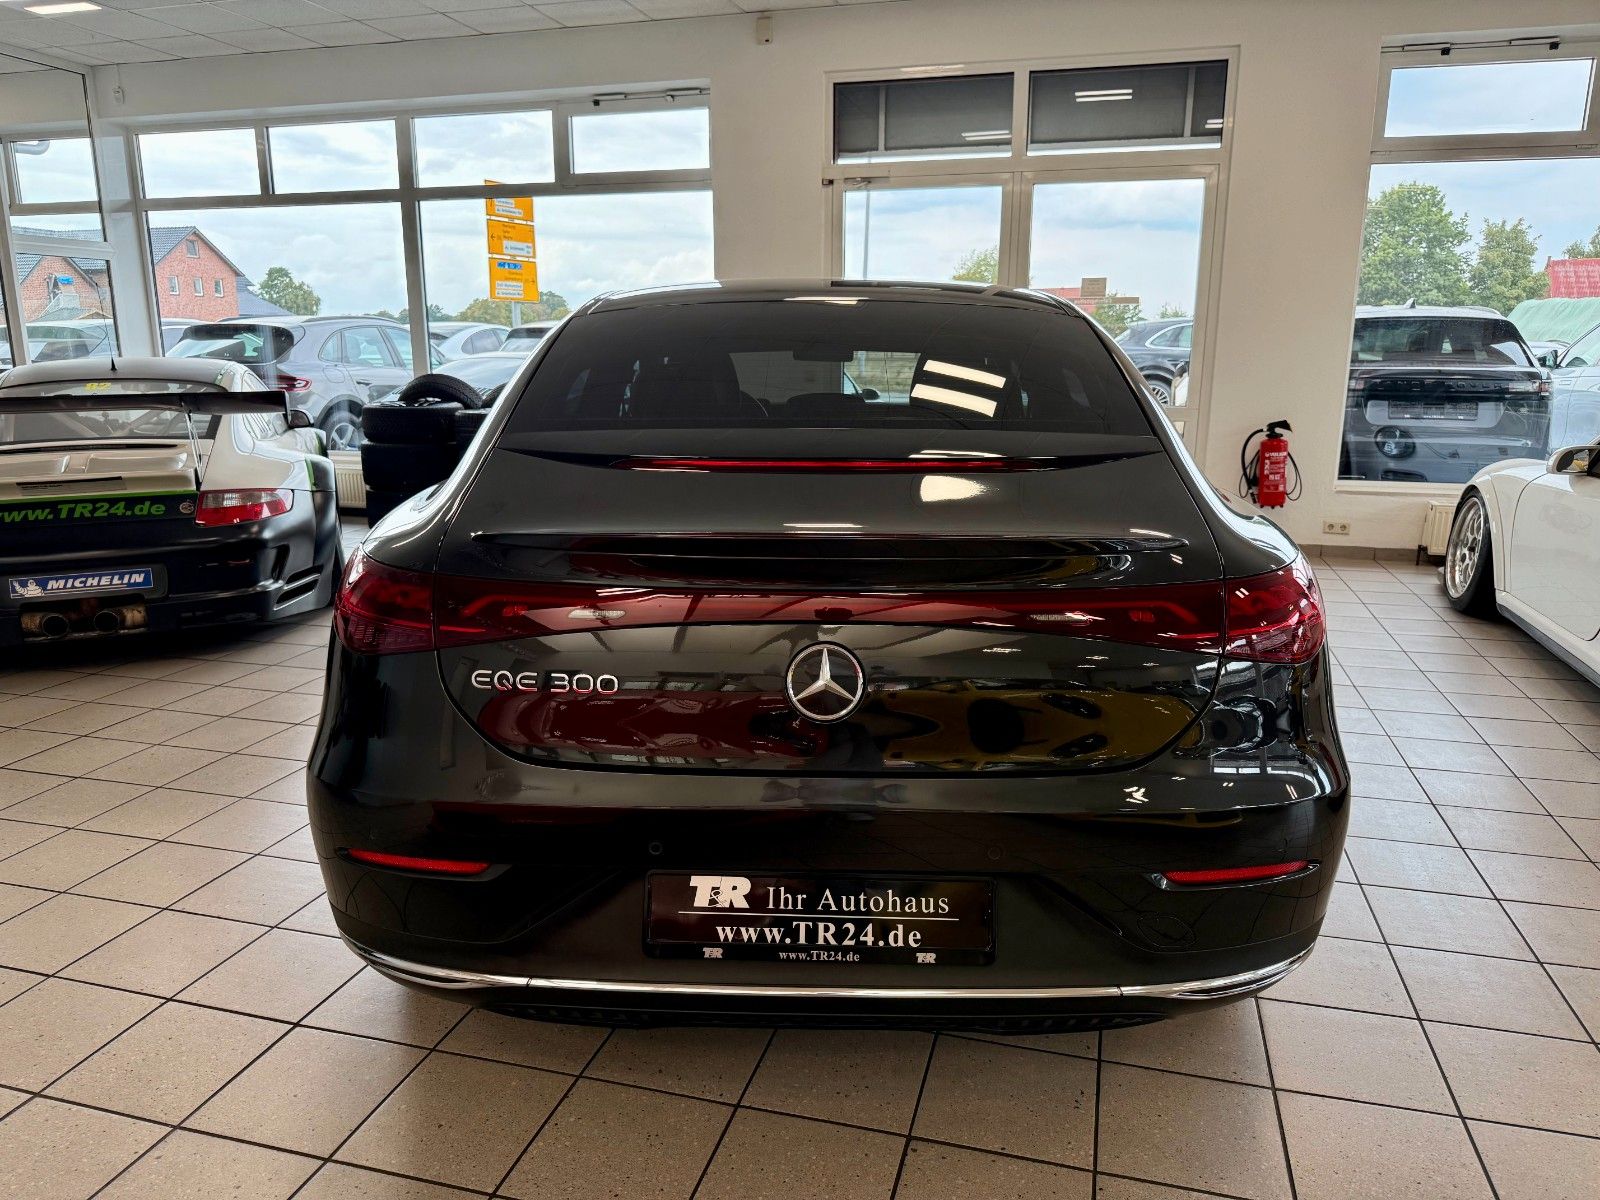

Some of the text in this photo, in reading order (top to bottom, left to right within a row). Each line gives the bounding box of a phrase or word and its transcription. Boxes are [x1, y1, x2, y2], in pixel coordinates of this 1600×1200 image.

[46, 573, 145, 590] MICHELIN
[471, 669, 619, 695] EQE 300
[766, 886, 807, 910] Ihr
[817, 887, 950, 914] Autohaus
[715, 921, 922, 947] www.TR24.de
[778, 950, 860, 962] www.TR24.de
